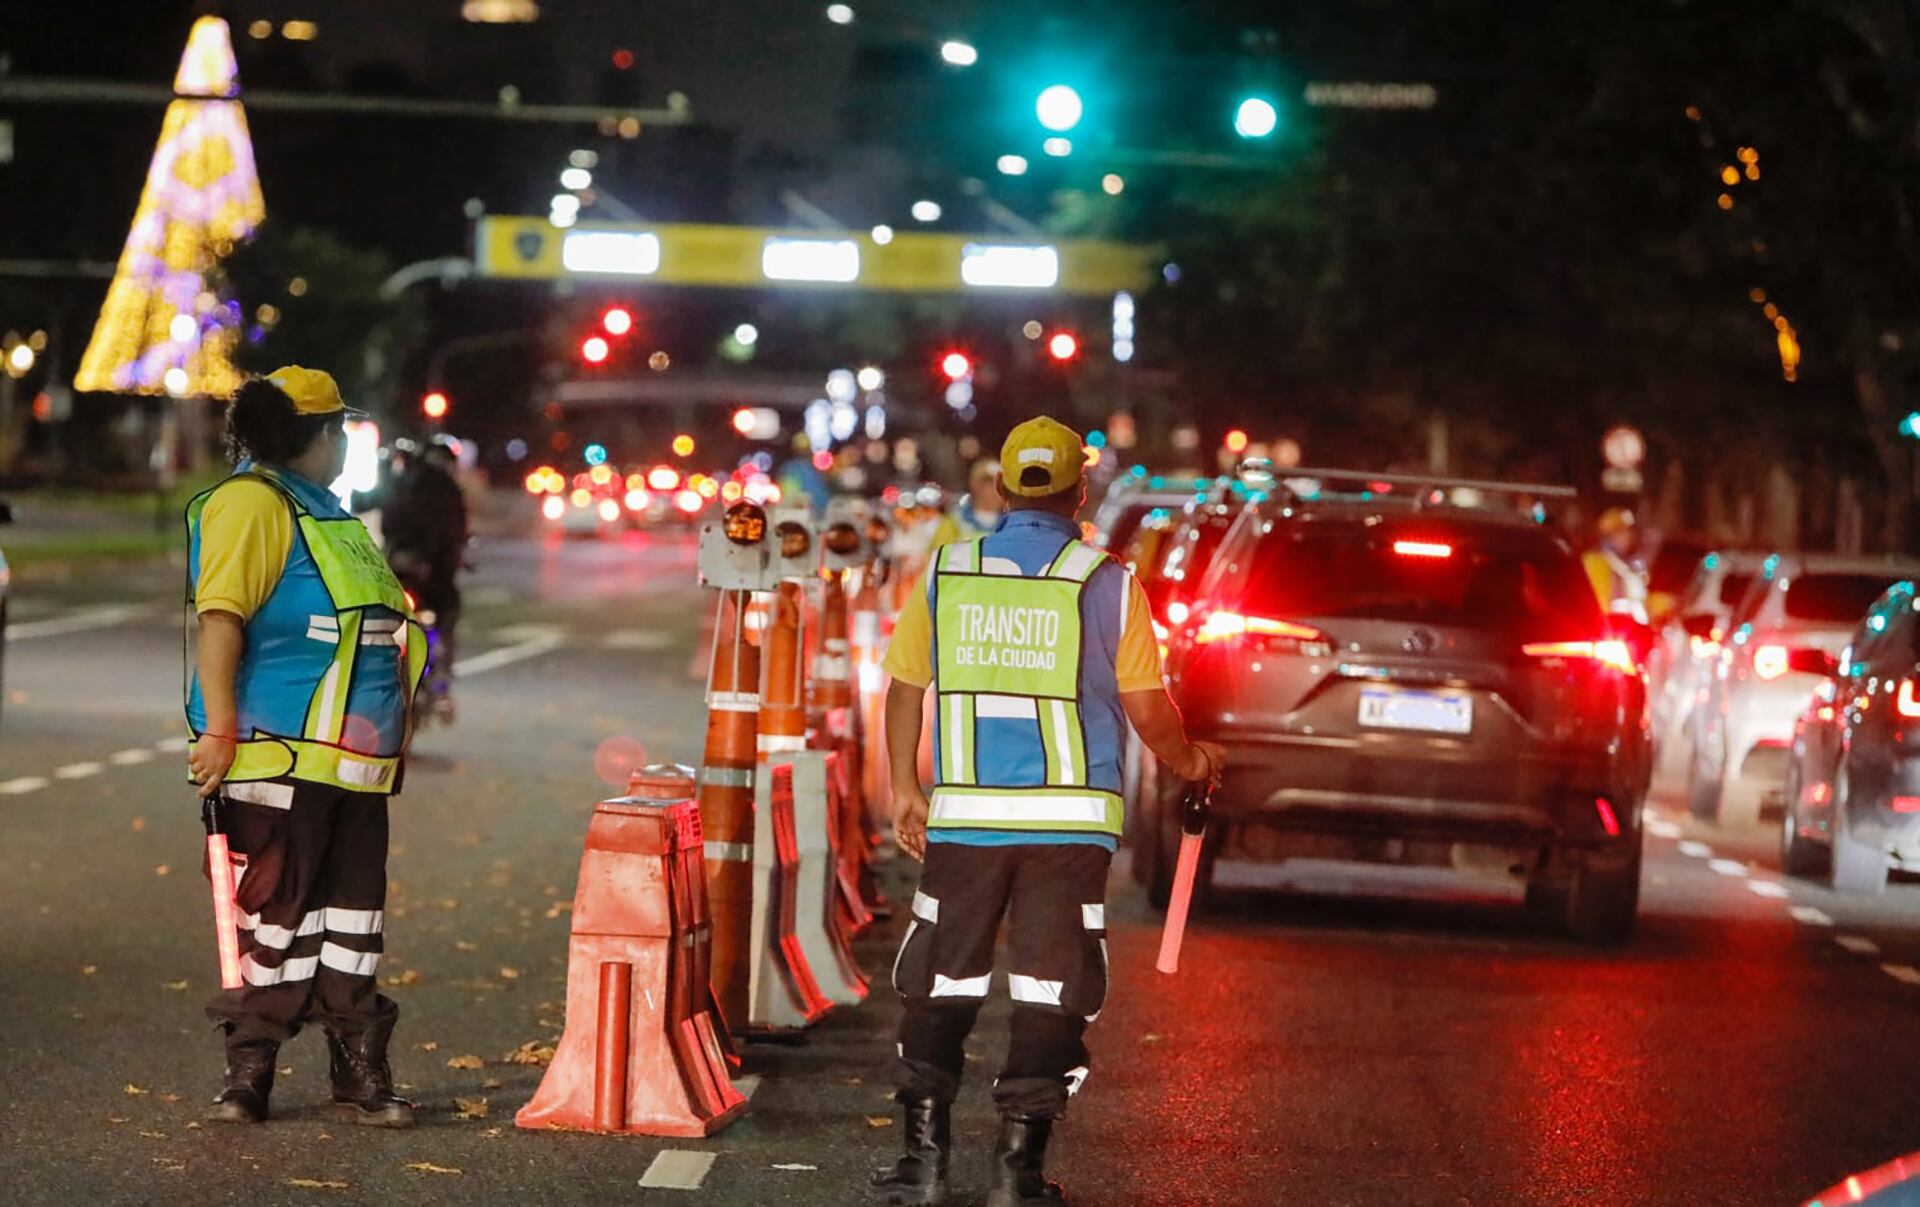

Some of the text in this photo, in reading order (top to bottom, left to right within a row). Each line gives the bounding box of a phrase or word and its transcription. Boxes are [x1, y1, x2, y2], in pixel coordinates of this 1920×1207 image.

[959, 604, 1059, 647] TRANSITO
[957, 646, 1056, 670] DE LA CIUDAD
